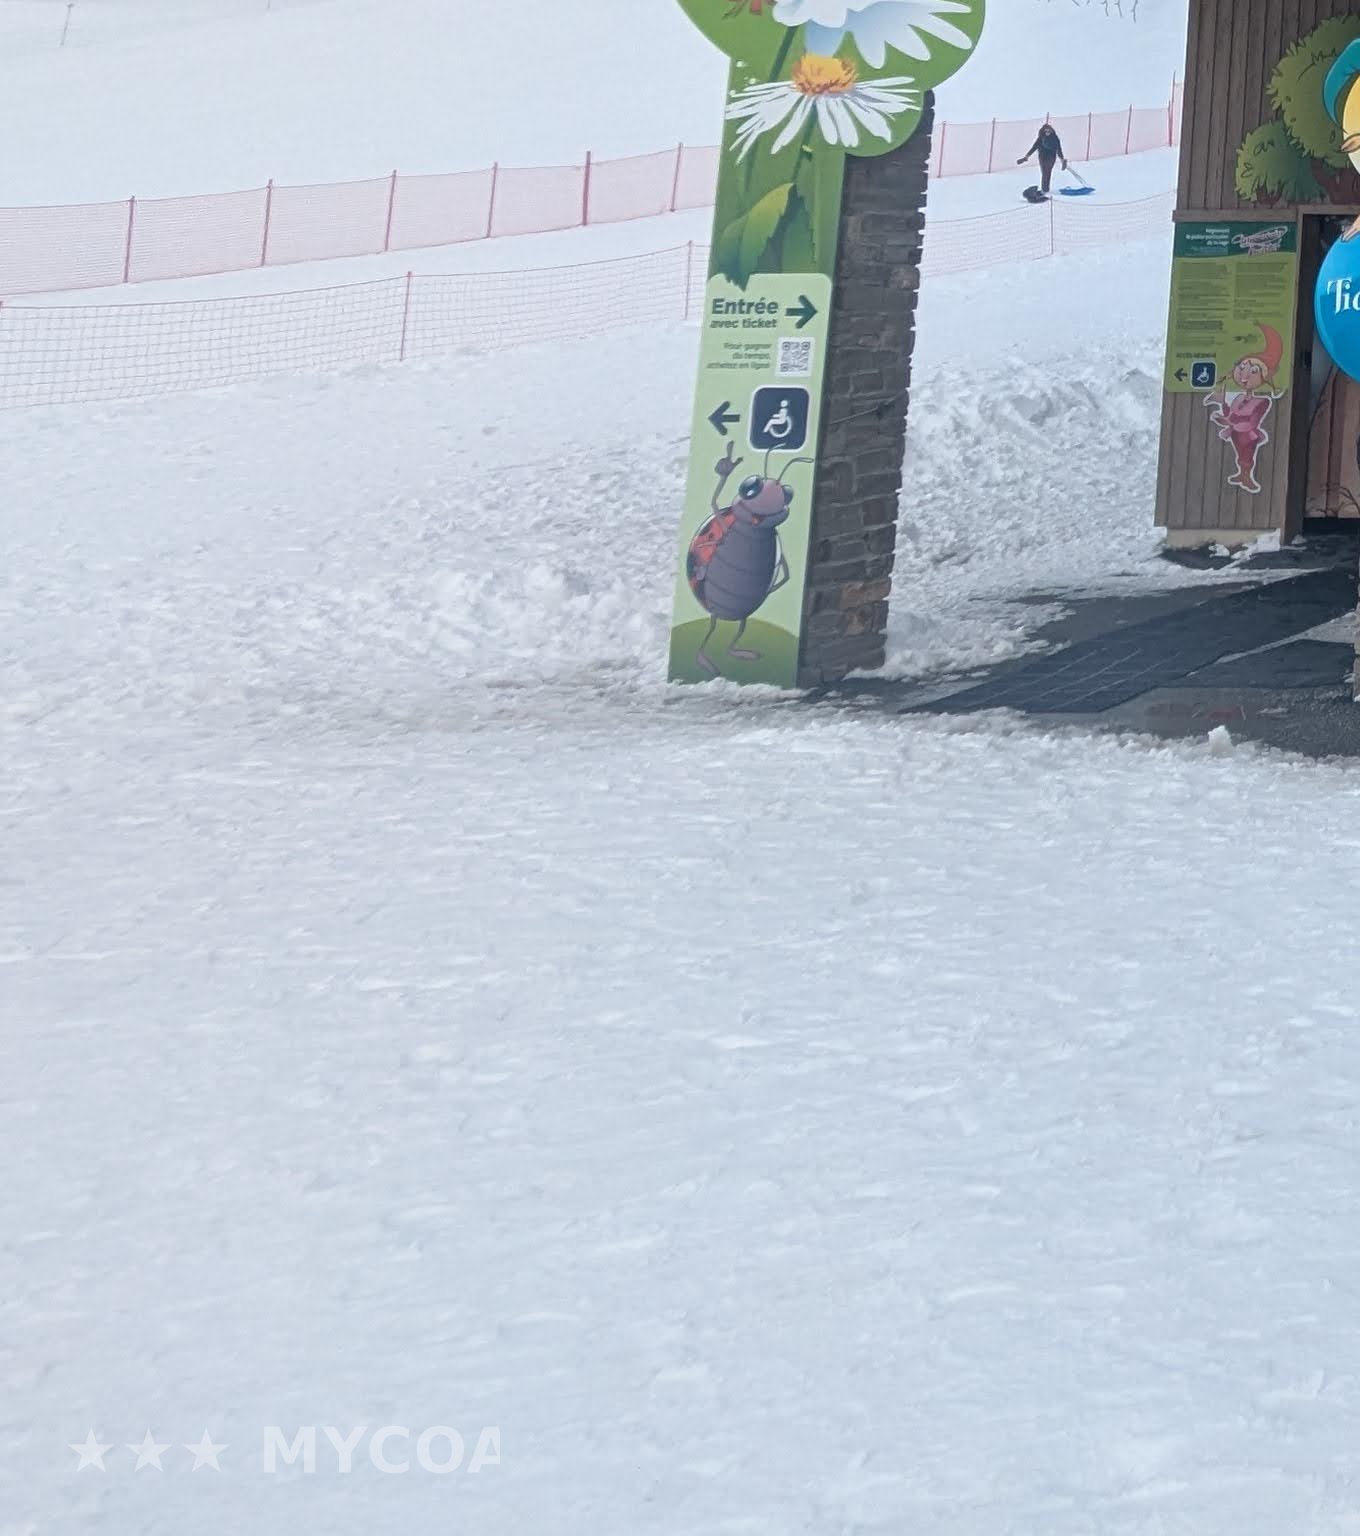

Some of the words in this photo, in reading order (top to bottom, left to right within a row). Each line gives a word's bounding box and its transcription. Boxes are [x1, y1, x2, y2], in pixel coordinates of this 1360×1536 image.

[711, 297, 779, 314] Entrée
[709, 319, 739, 328] avec
[742, 318, 777, 329] ticket
